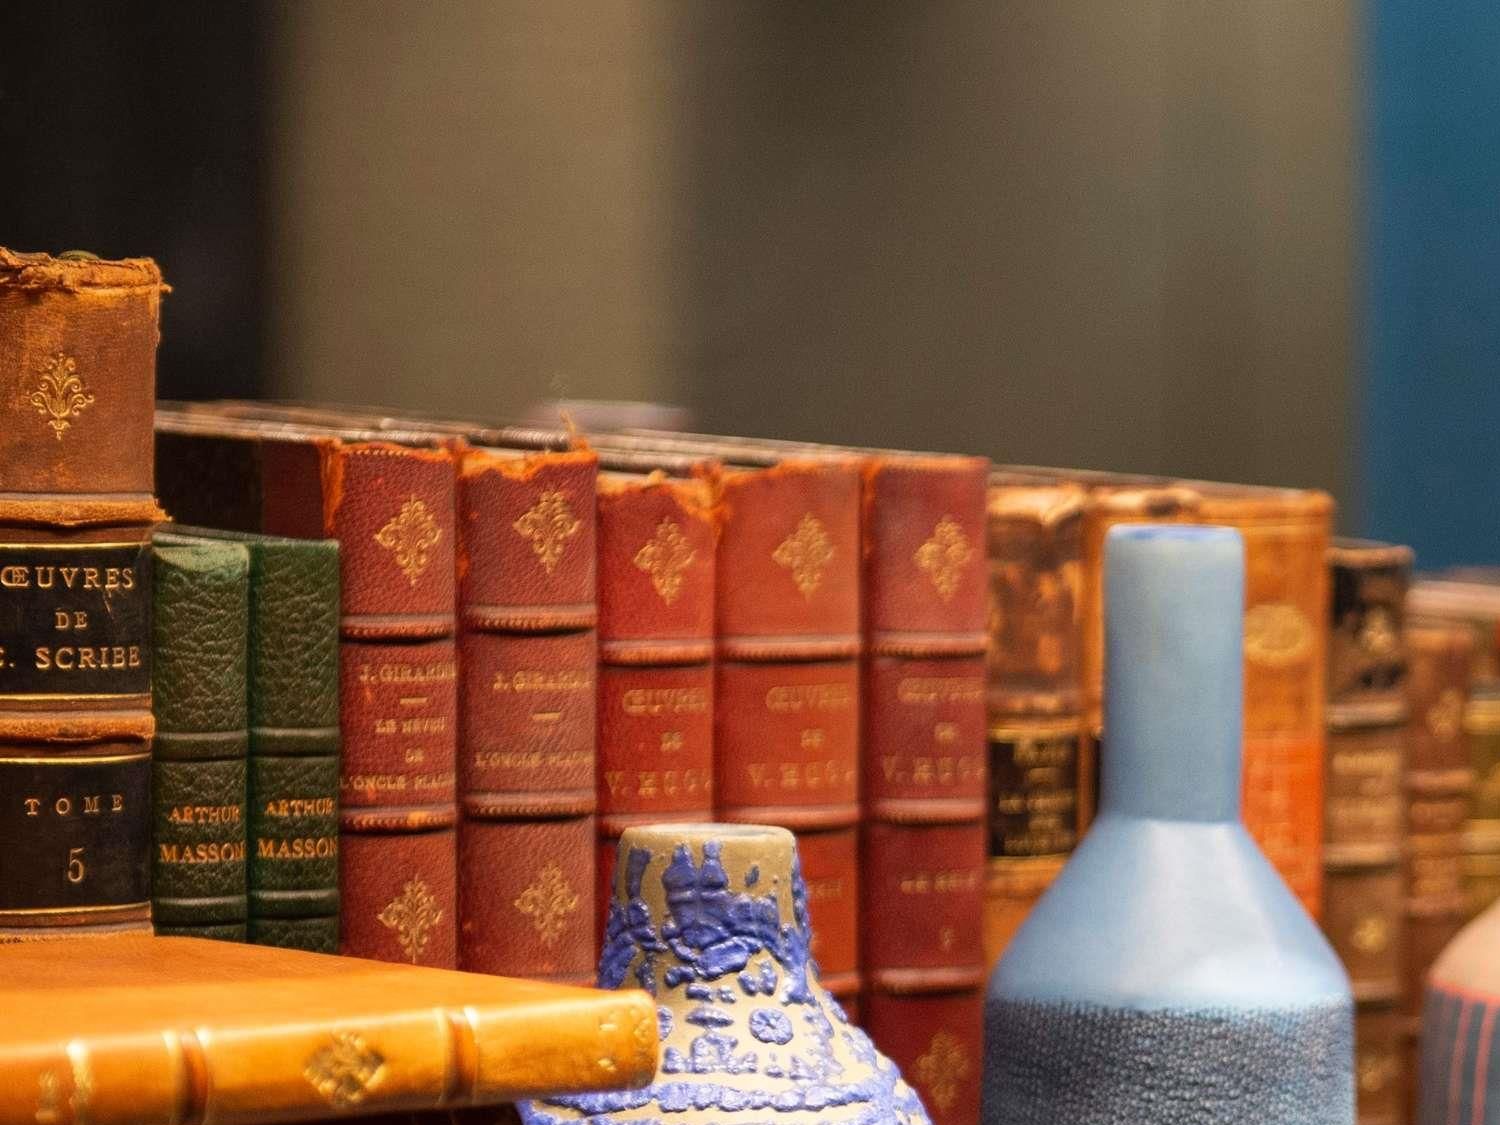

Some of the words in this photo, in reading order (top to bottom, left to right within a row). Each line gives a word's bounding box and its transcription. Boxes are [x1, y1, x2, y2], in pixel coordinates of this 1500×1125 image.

[0, 565, 135, 589] ŒUVRES
[54, 610, 88, 629] DE
[35, 646, 141, 669] SCRIBE
[24, 794, 123, 816] TOME
[168, 805, 241, 824] ARTHUR
[265, 797, 335, 816] ARTHUR
[159, 841, 245, 864] MASSON
[257, 837, 338, 860] MASSON
[67, 847, 86, 882] 5
